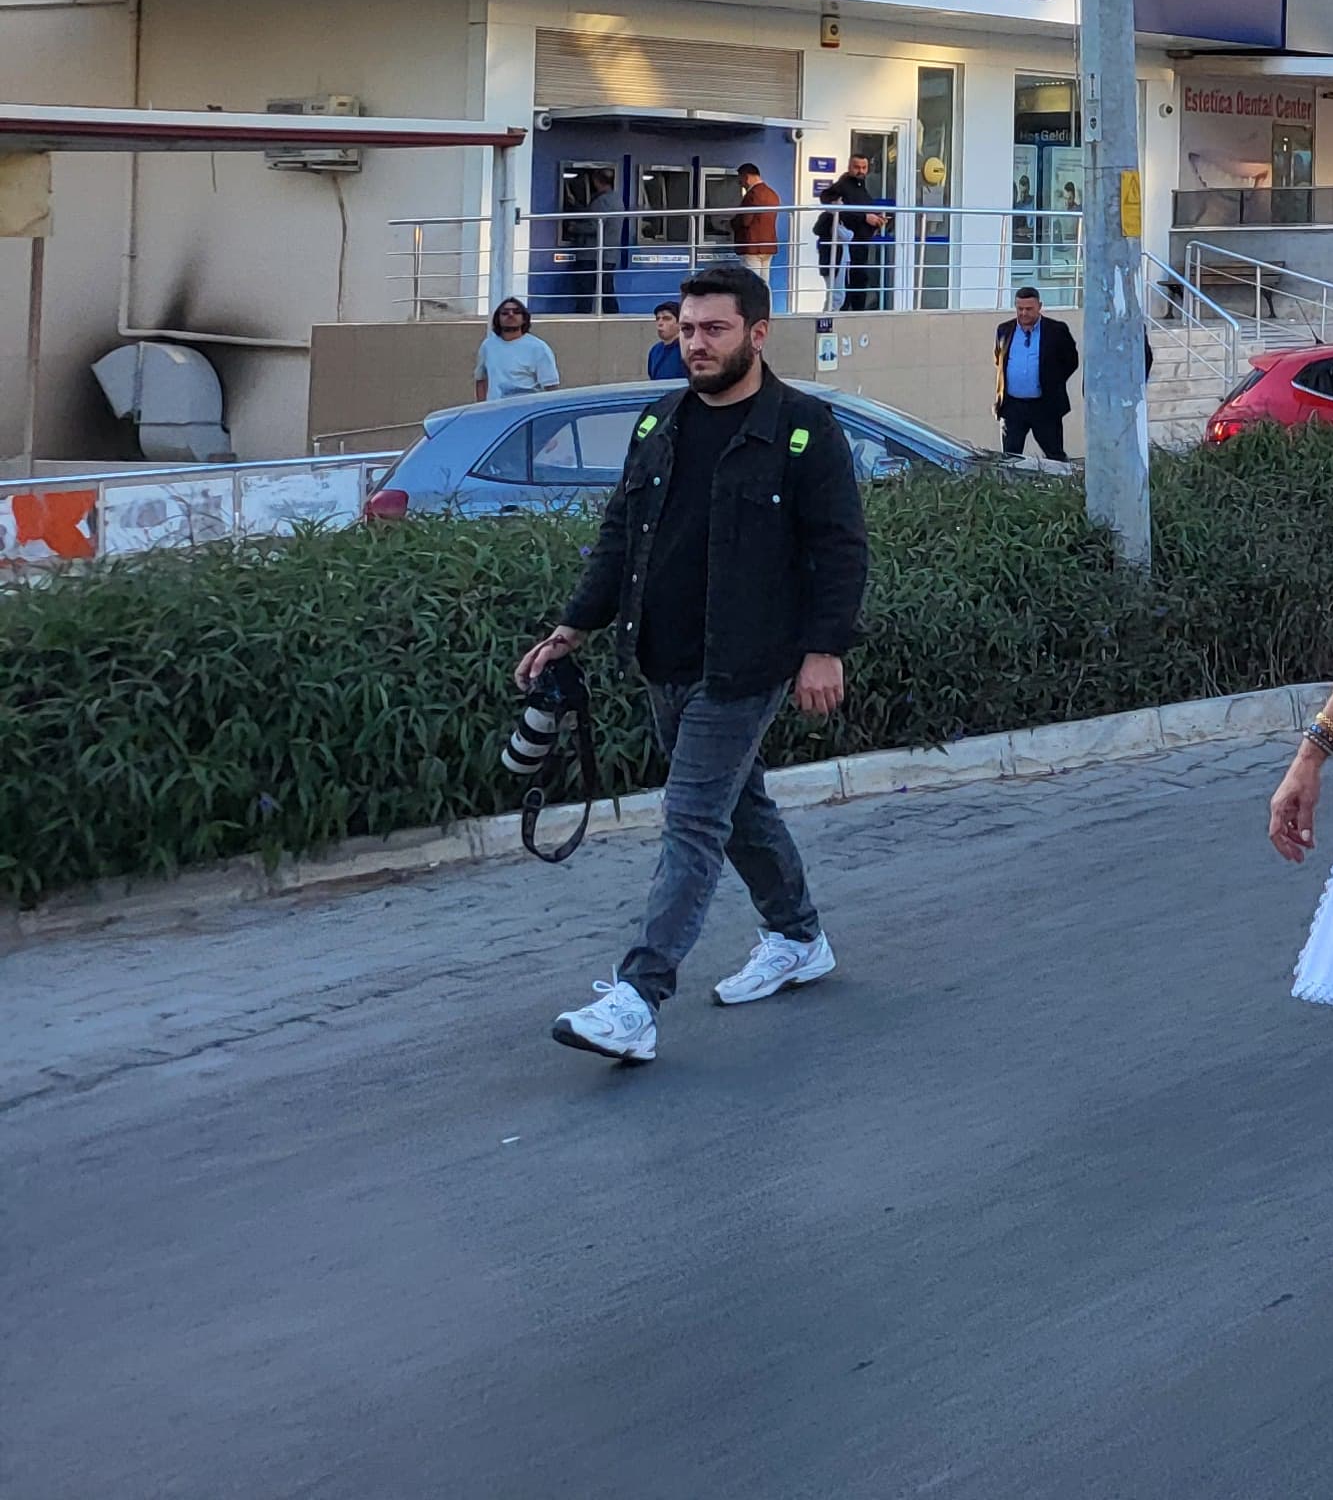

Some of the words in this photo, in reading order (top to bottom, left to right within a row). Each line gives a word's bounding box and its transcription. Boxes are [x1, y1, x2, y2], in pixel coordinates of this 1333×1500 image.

[1184, 86, 1233, 115] Estetica
[1236, 90, 1274, 117] Dental
[1275, 93, 1313, 120] Center
